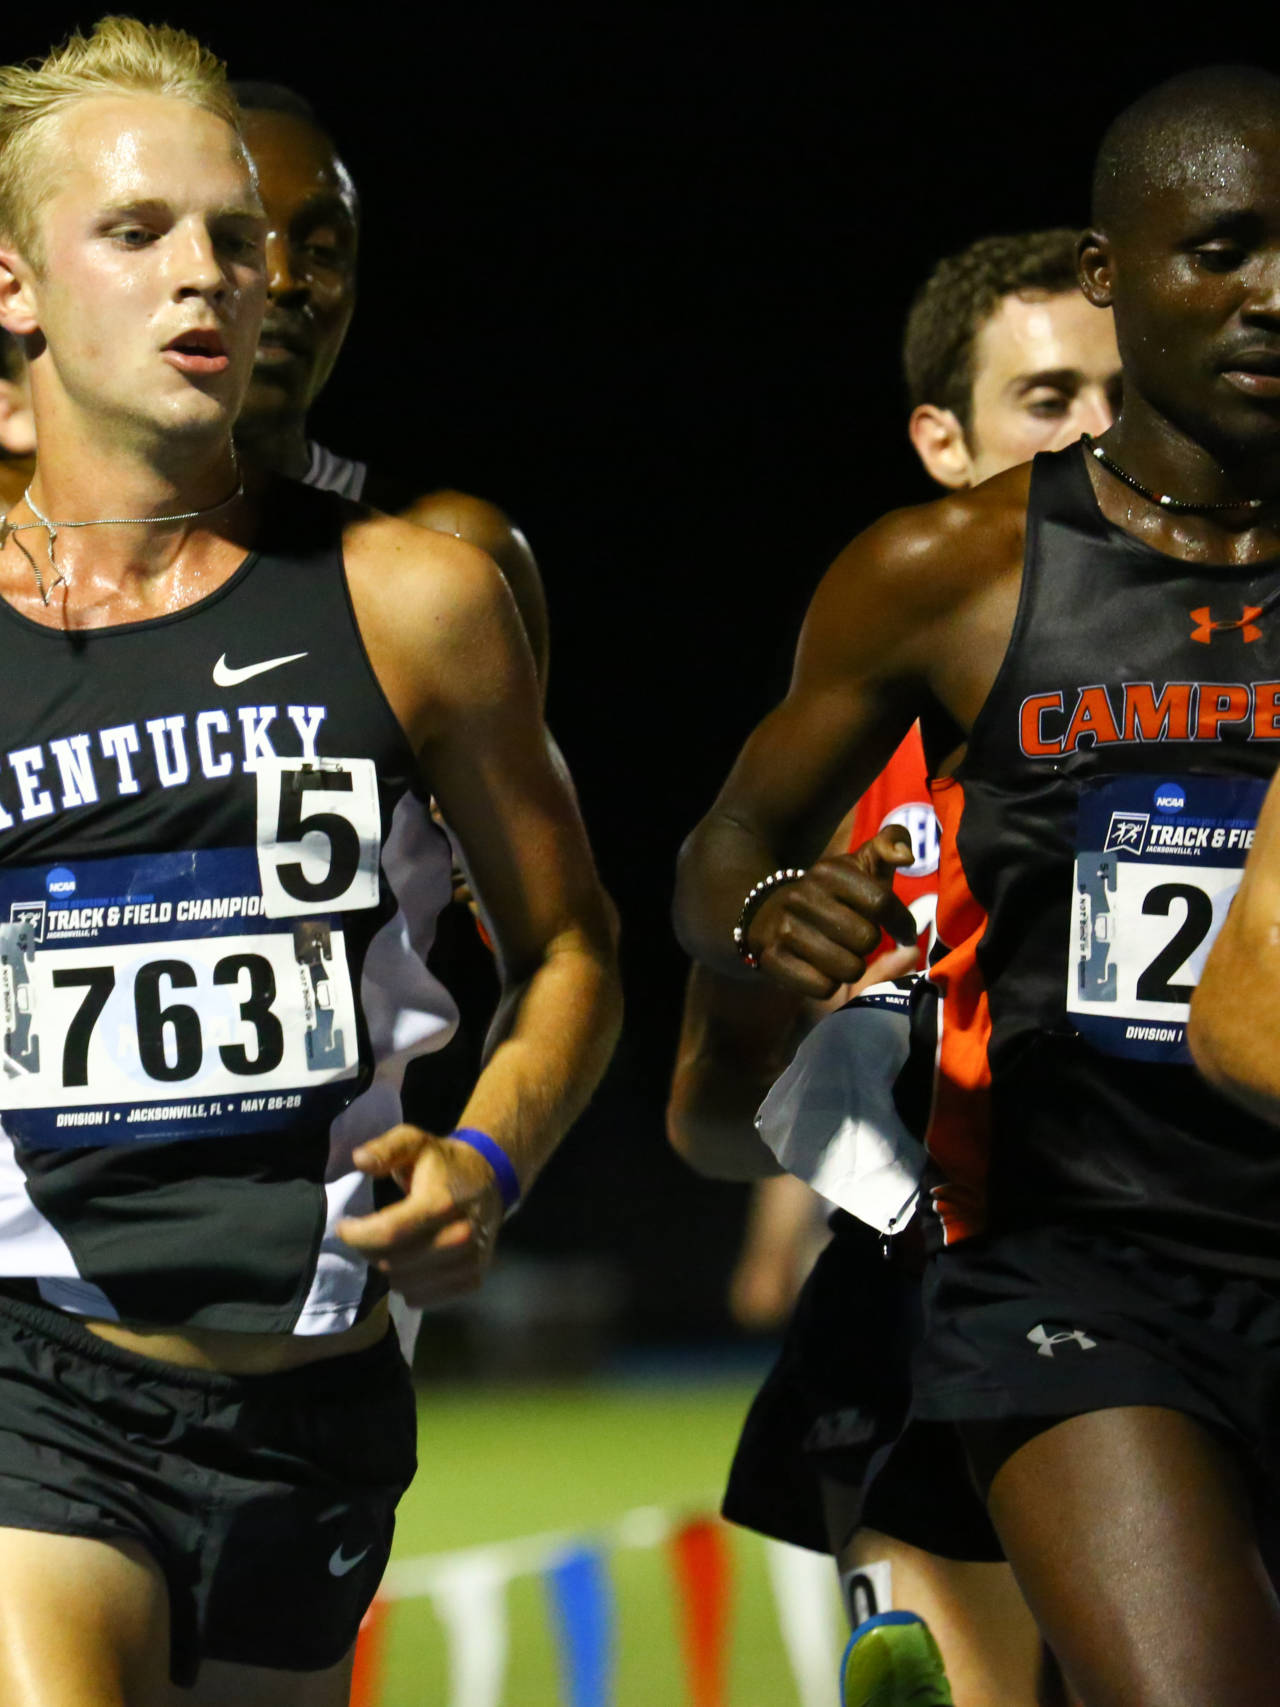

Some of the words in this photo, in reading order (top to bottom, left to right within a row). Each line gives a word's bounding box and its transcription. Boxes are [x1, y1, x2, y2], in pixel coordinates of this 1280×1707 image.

[1156, 797, 1185, 808] NCAA
[276, 770, 361, 903] 5
[1150, 825, 1208, 847] TRACK
[1211, 829, 1226, 848] &
[47, 908, 104, 931] TRACK
[106, 906, 121, 926] &
[122, 900, 173, 925] FIELD
[1136, 883, 1213, 1002] 2
[52, 953, 284, 1088] 763
[1125, 1026, 1176, 1042] DIVISION
[1177, 1030, 1183, 1042] I
[56, 1112, 103, 1128] DIVISION
[104, 1111, 110, 1124] I
[126, 1104, 208, 1123] JACKSONVILLE,
[209, 1102, 222, 1116] FL
[240, 1098, 266, 1113] MAY
